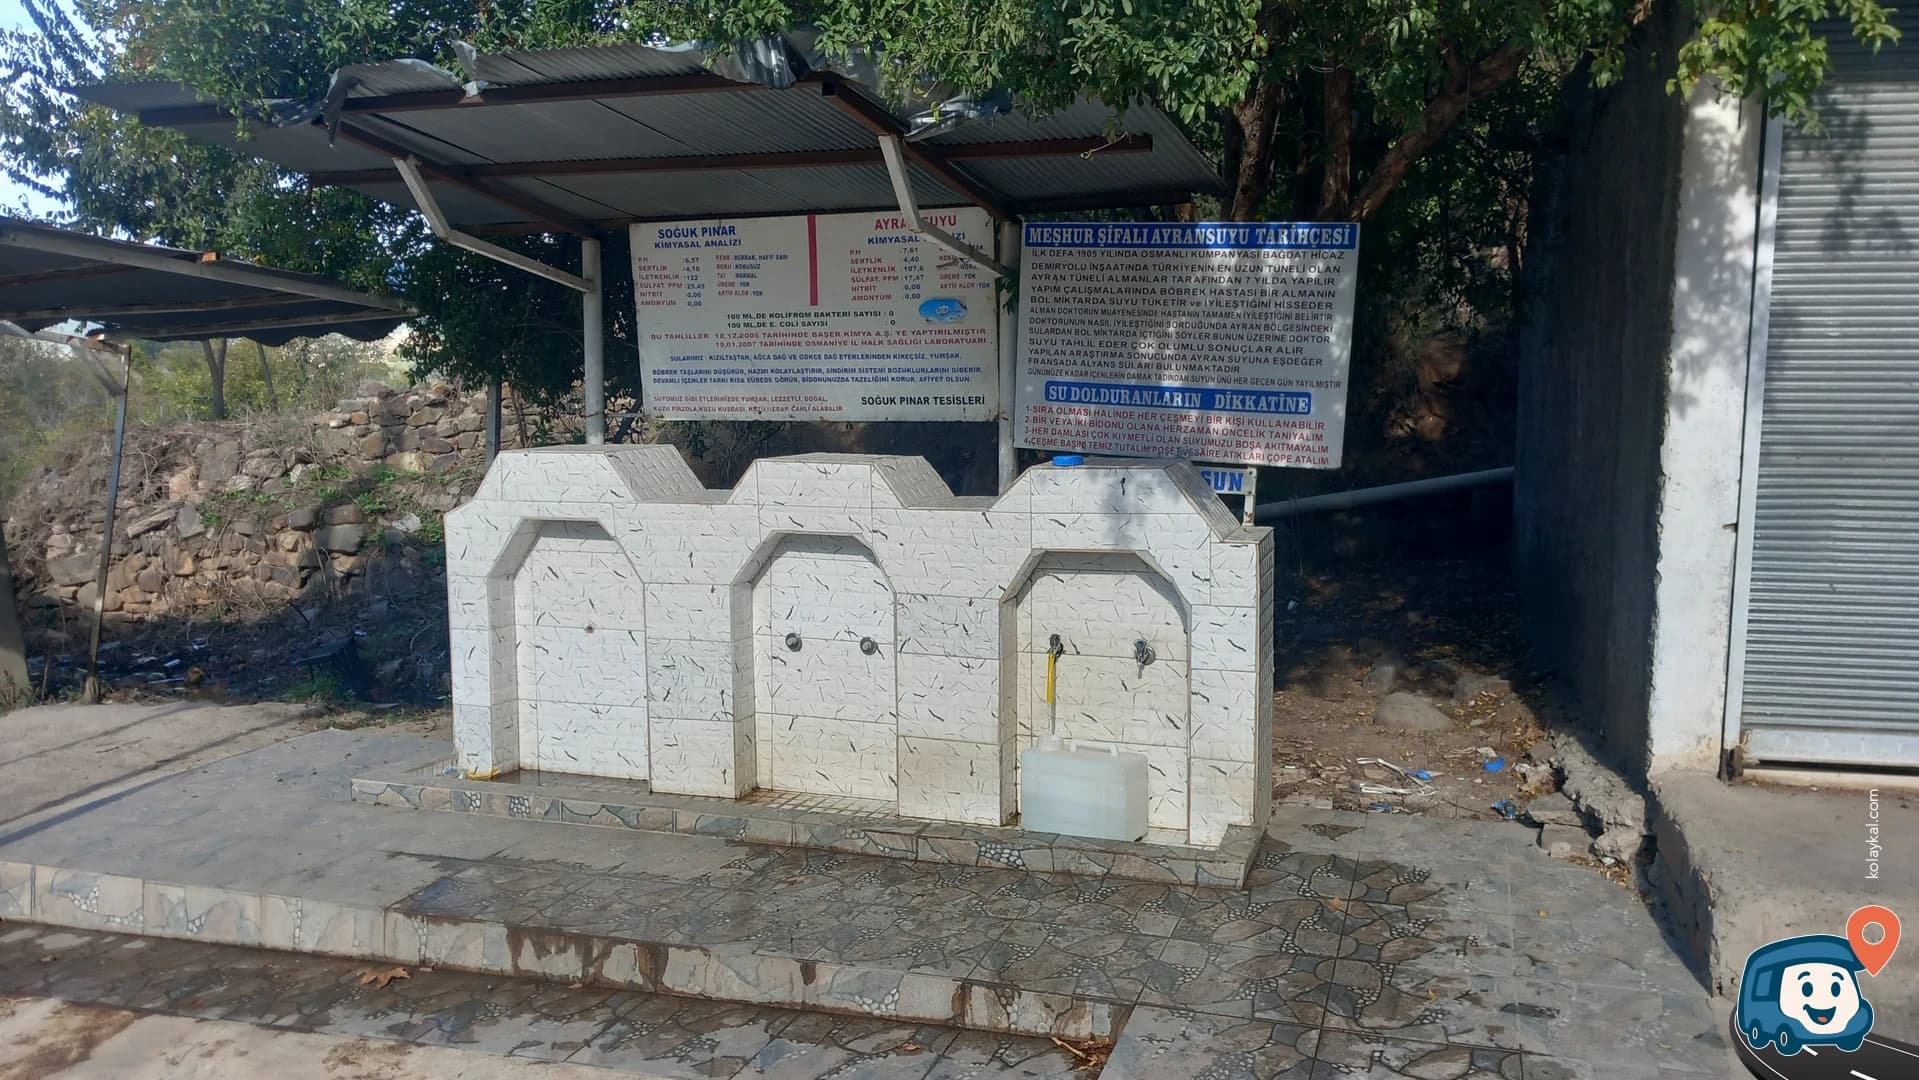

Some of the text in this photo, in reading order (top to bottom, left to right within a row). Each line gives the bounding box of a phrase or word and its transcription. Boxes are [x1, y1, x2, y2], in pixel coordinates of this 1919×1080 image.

[702, 226, 736, 237] PINAR
[1029, 225, 1350, 247] MEŞHUR ŞİFALI AYRANSUYU TARİHÇESİ
[1141, 250, 1188, 258] OSMANLI
[1108, 275, 1168, 283] ALMANLAR
[1172, 276, 1242, 284] TARAFINDAN
[1032, 285, 1060, 293] YAPIM
[1158, 342, 1203, 351] OLUMLU
[1028, 358, 1077, 366] FRANSADA
[861, 394, 984, 405] SOĞUK PINAR TESİSLERİ
[1049, 386, 1309, 413] SU DOLDURANLARIN DİKKATİNE
[1050, 417, 1072, 425] VEYA
[1127, 421, 1160, 431] OLANA
[1156, 434, 1180, 443] OLAN
